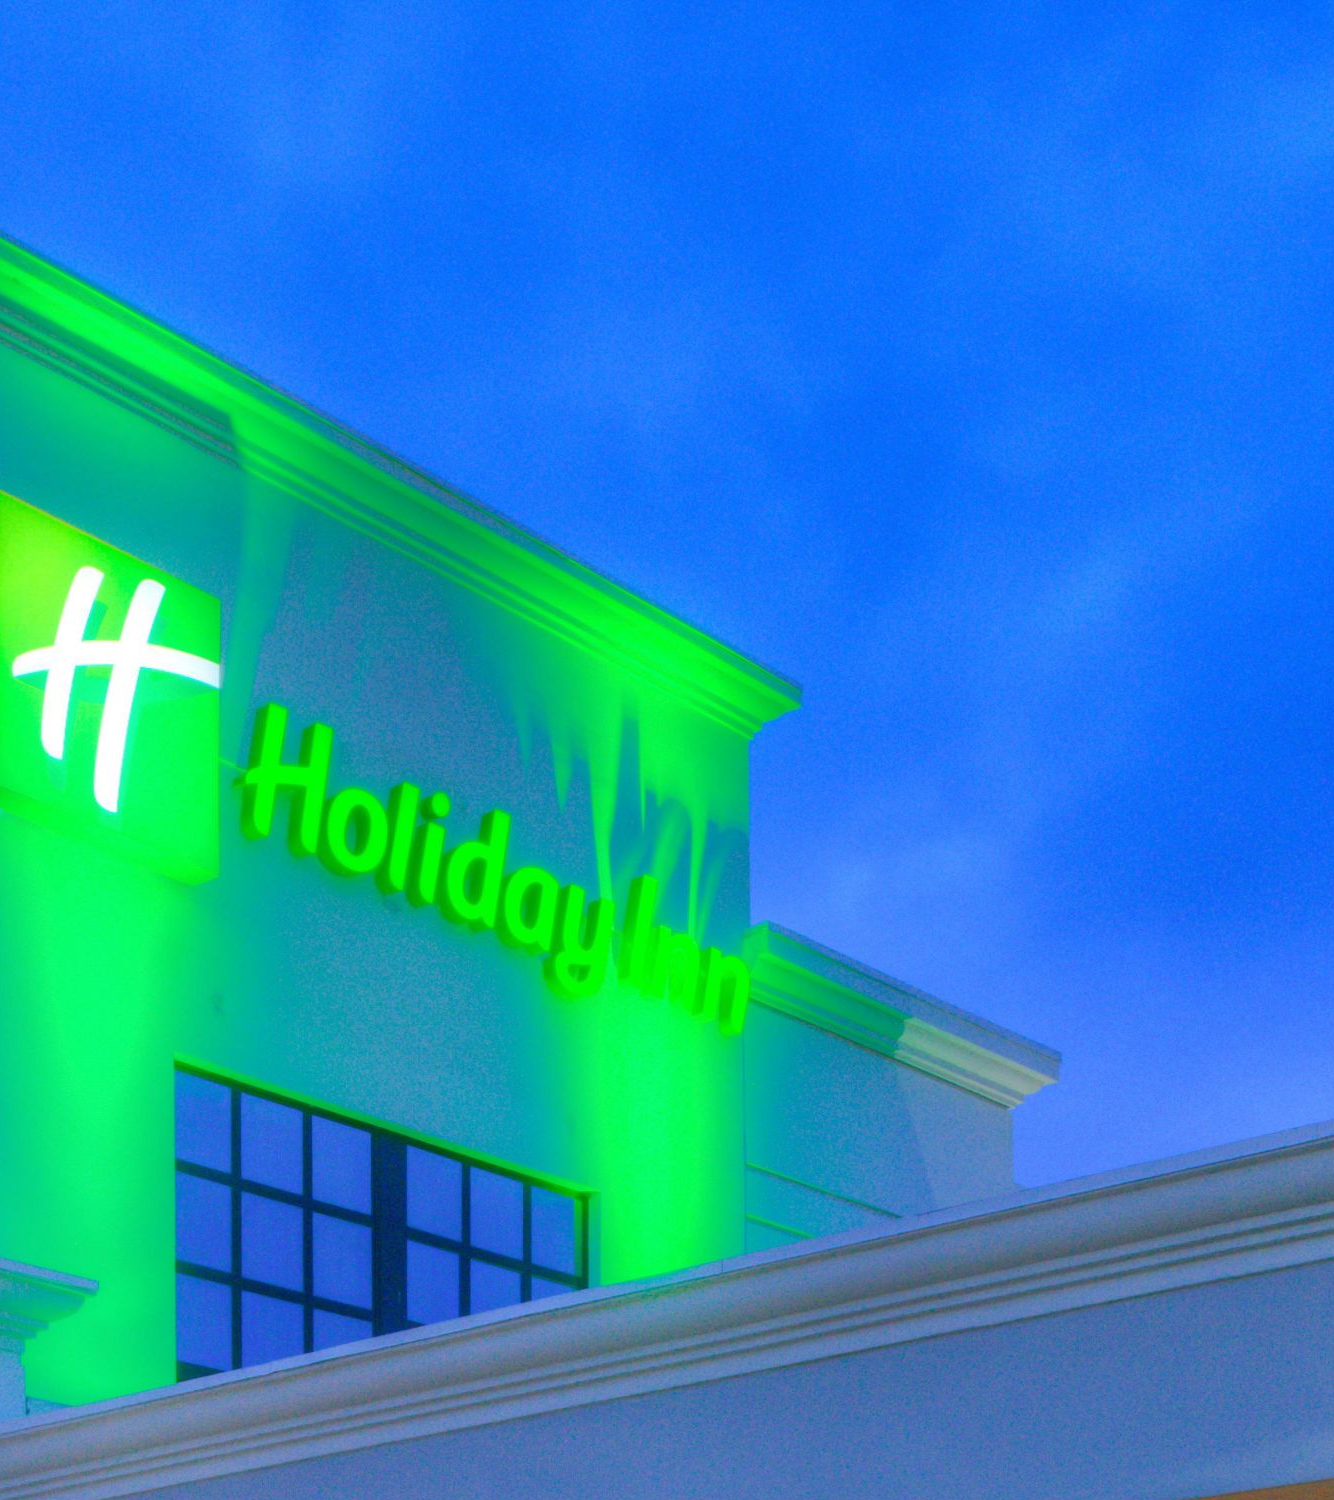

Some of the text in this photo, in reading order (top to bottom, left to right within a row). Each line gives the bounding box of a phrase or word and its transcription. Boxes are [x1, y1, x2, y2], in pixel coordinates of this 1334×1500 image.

[11, 565, 221, 814] H
[234, 702, 751, 1037] Holiday Inn
